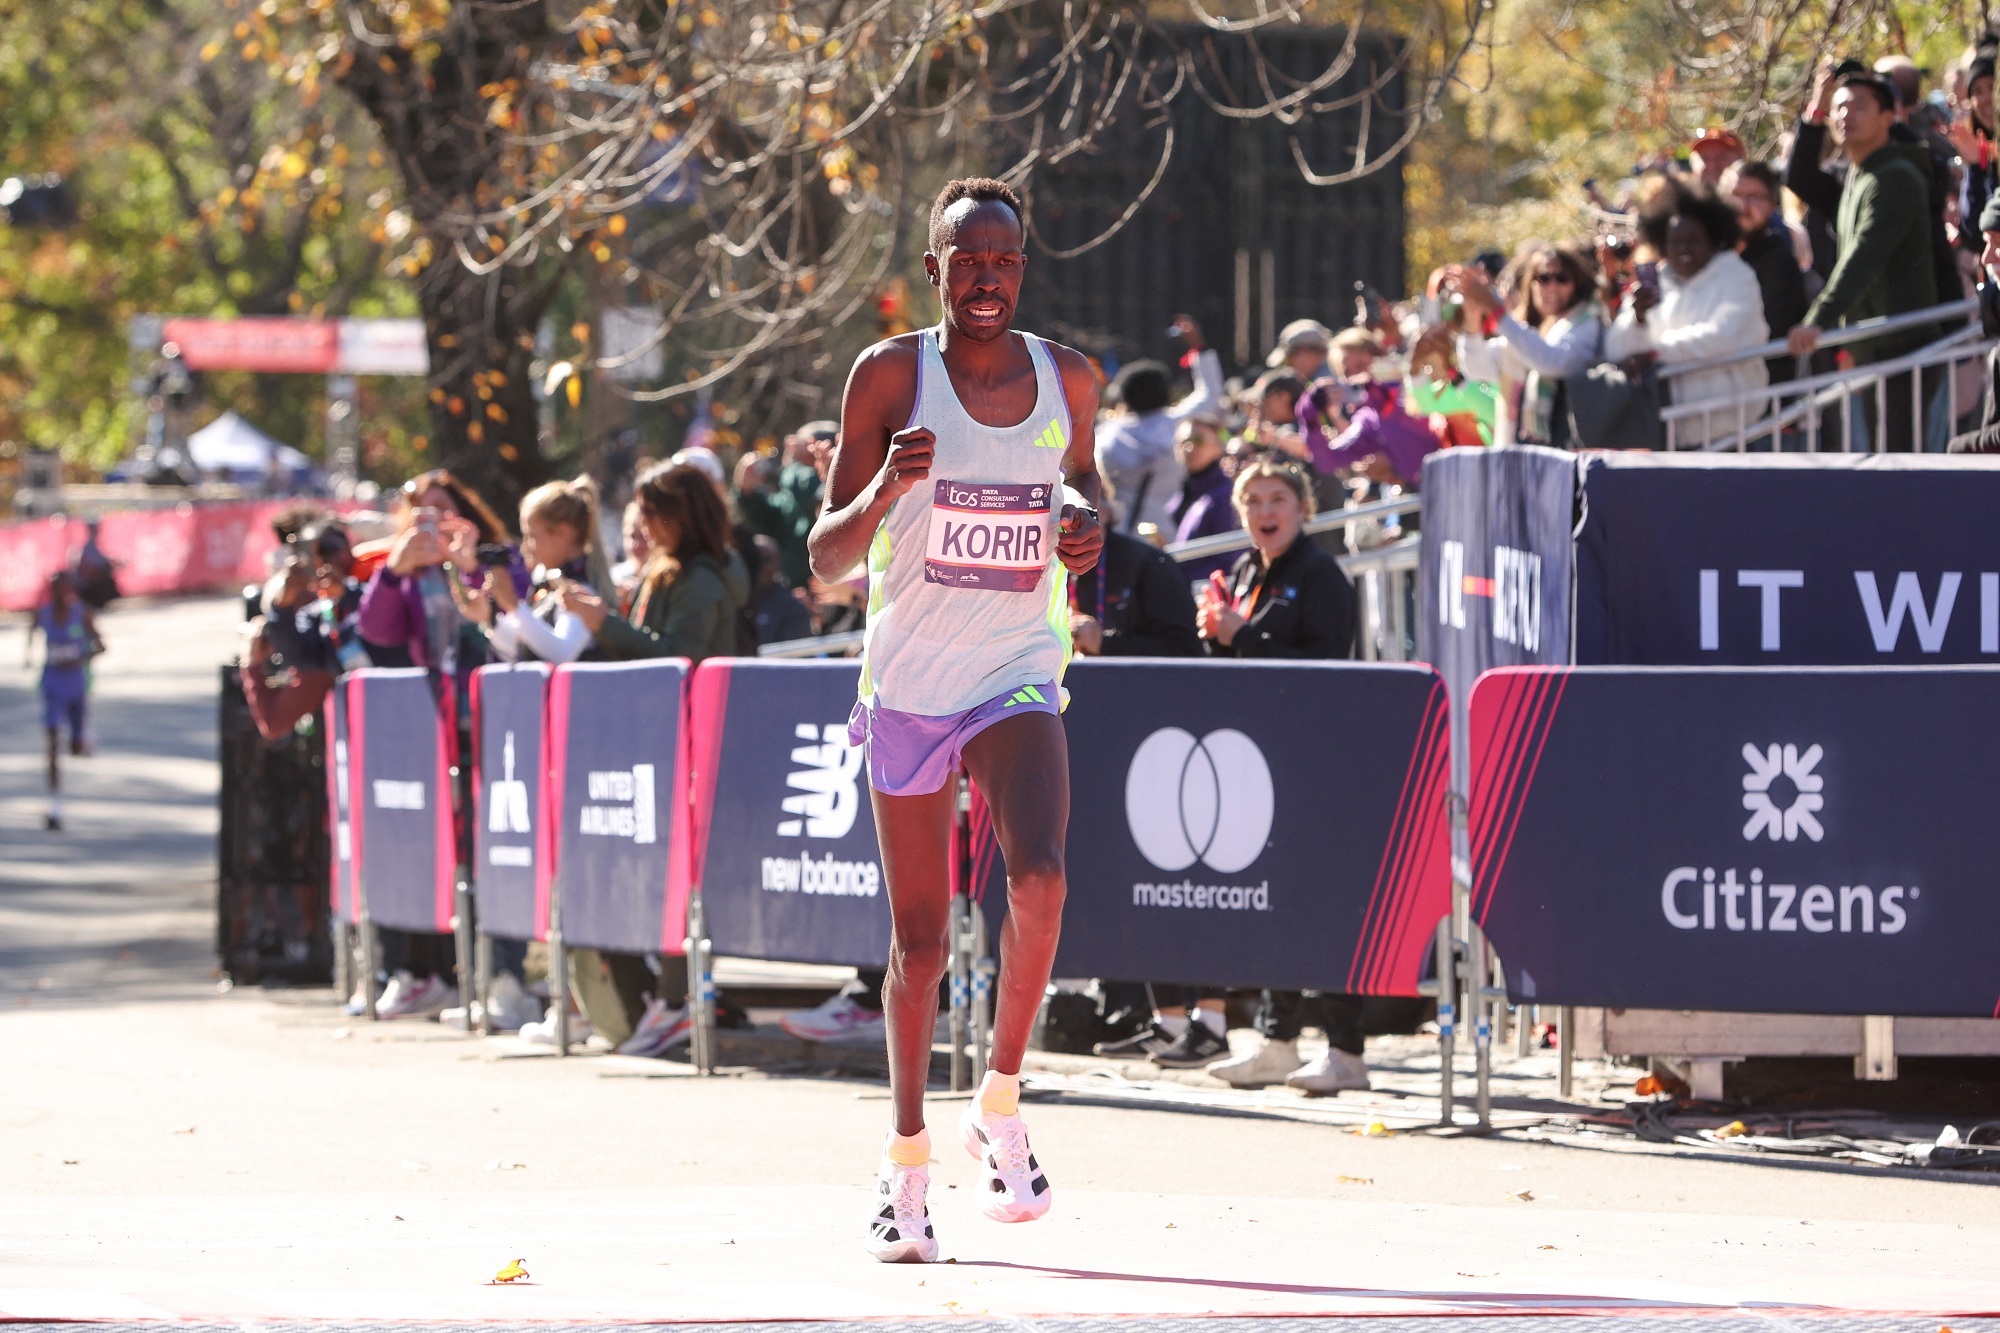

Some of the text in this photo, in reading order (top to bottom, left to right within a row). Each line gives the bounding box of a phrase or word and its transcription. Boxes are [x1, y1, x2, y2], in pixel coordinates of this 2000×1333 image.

[949, 486, 978, 507] tcs
[1028, 500, 1044, 508] TATA
[941, 521, 1042, 561] KORIR
[1700, 569, 1999, 653] IT WI
[761, 850, 879, 897] new balance
[1132, 878, 1269, 911] mastercard
